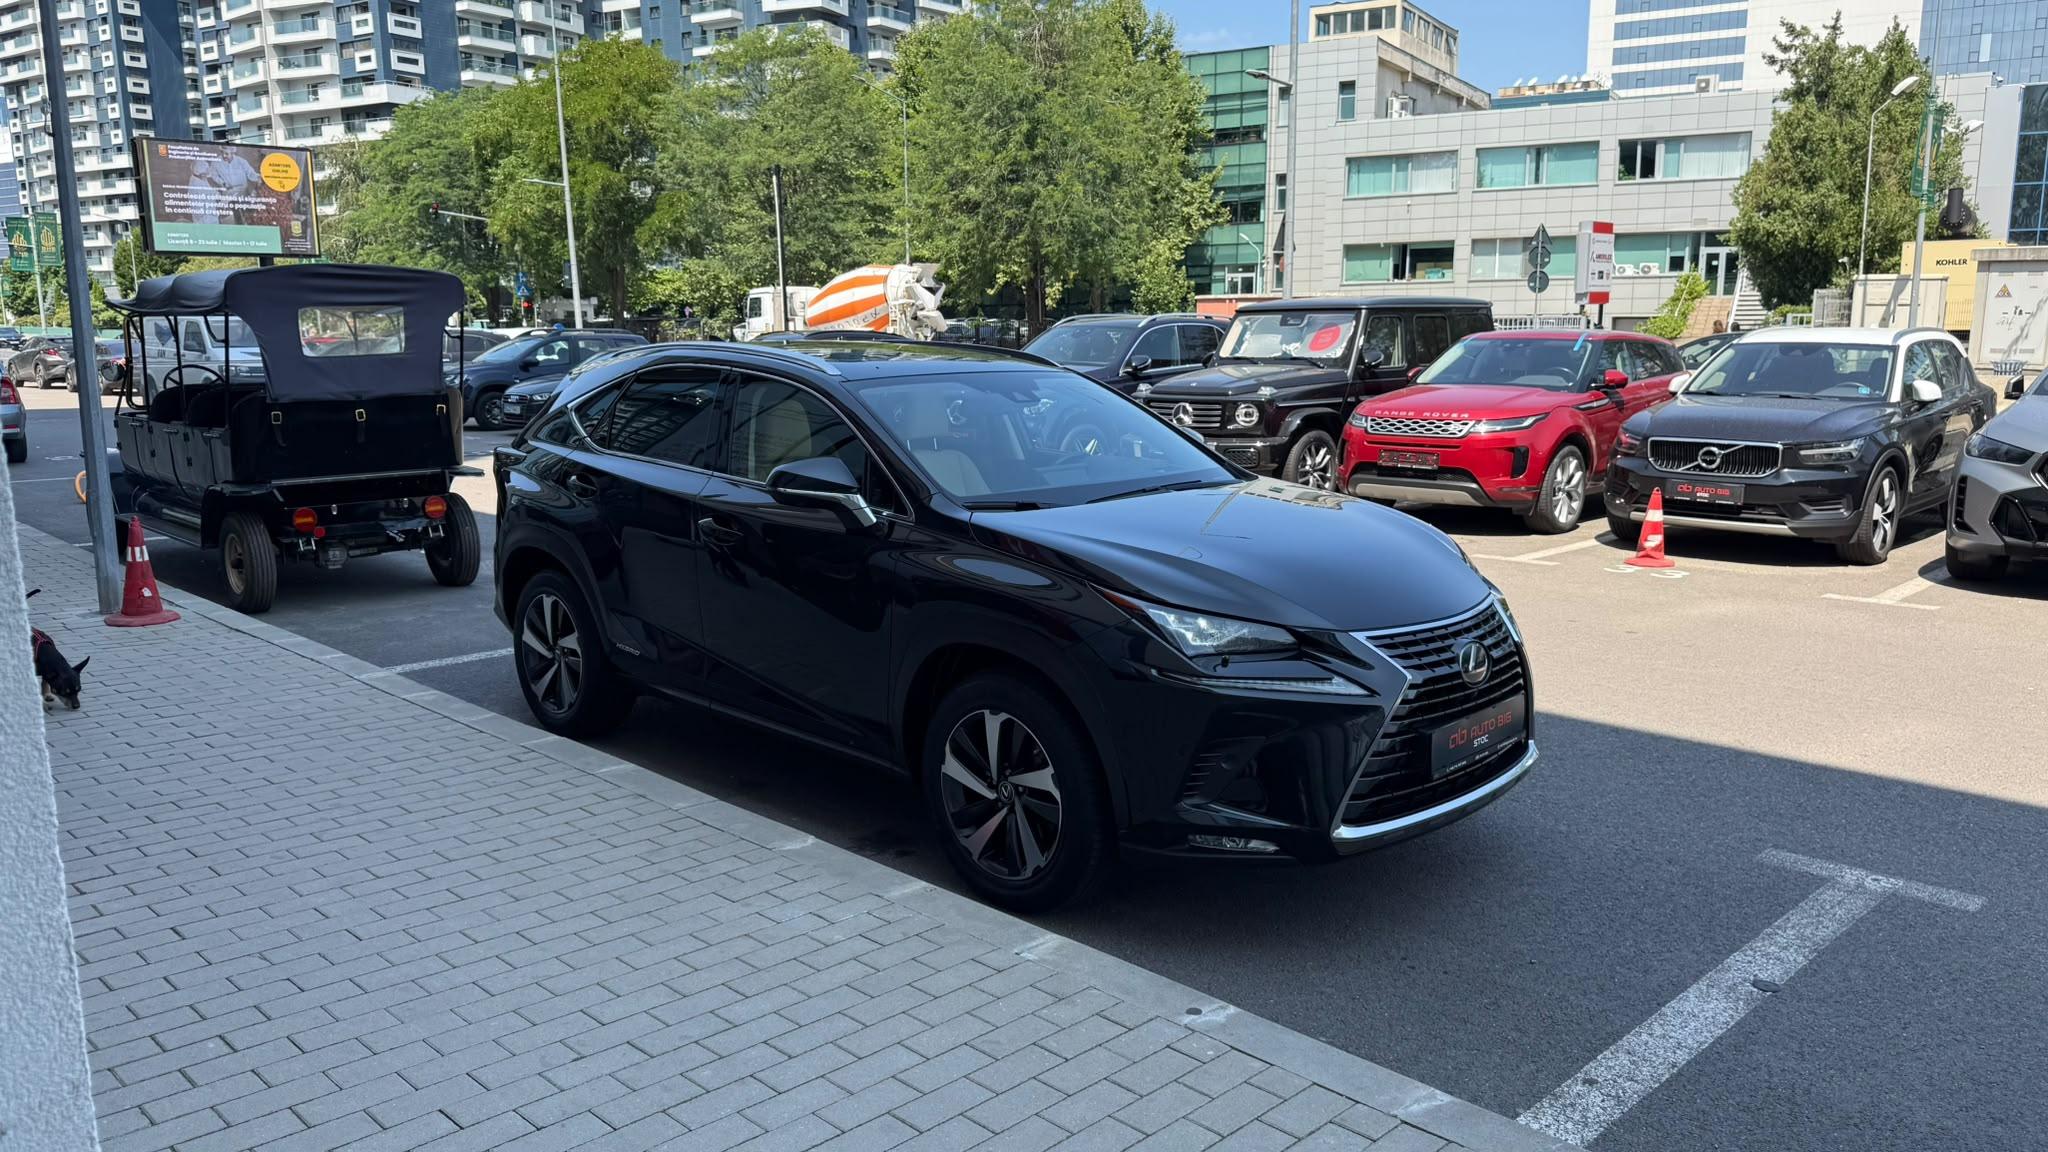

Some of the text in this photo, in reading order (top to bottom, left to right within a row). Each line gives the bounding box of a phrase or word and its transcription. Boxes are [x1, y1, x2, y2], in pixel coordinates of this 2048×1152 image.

[164, 191, 206, 200] Controlează
[164, 199, 204, 207] alimentelor
[1936, 258, 1968, 266] KOHLER
[1470, 718, 1496, 738] AUTO
[1497, 711, 1512, 727] BIG
[1473, 734, 1488, 747] STOC
